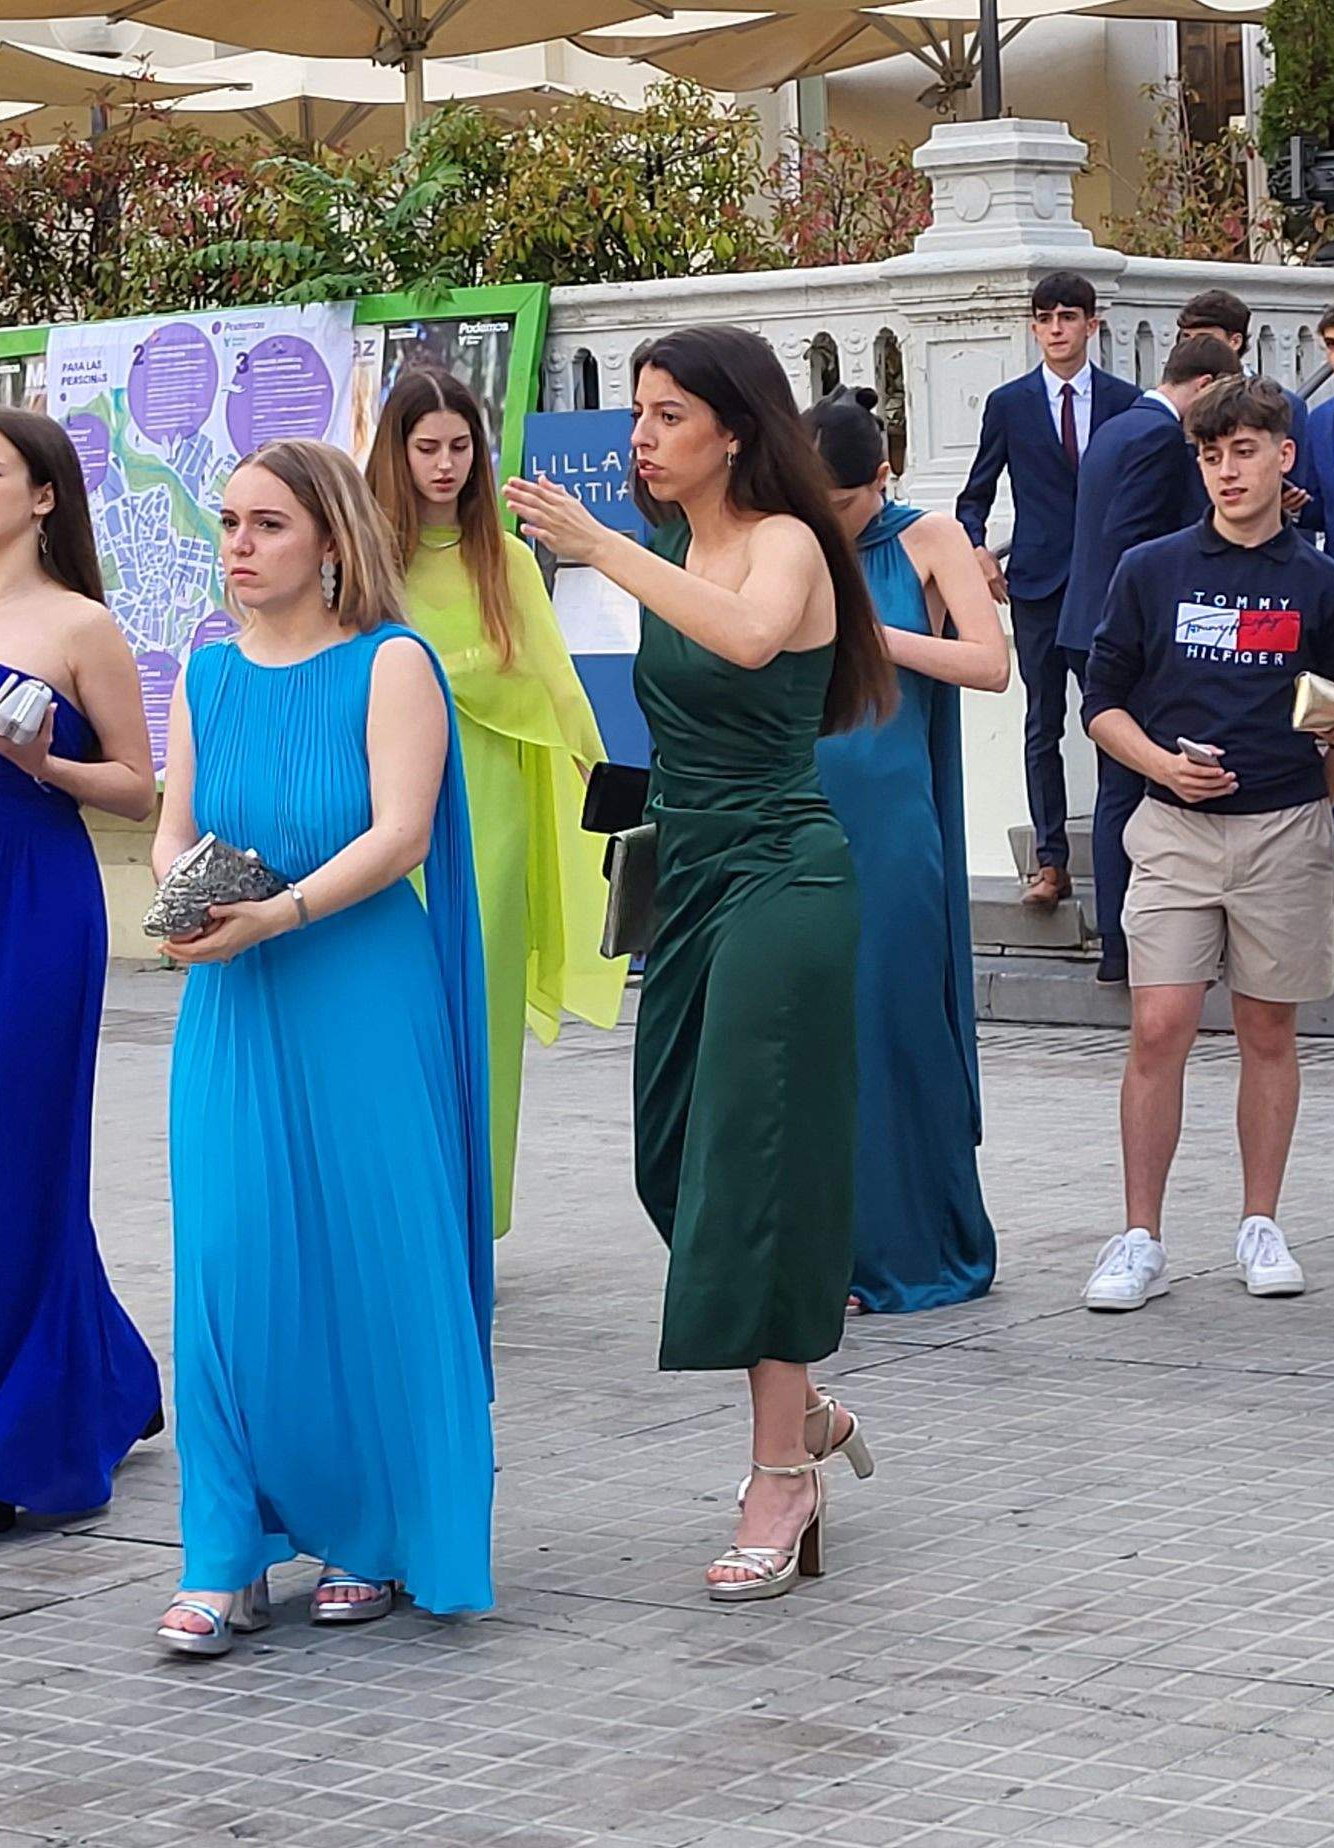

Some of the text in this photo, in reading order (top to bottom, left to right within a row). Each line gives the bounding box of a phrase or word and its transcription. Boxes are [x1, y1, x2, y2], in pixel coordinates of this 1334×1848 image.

[133, 344, 145, 366] 2
[236, 352, 249, 374] 3
[532, 451, 633, 476] LILLA
[1193, 591, 1289, 611] TOMMY
[1186, 645, 1284, 665] HILFIGER
